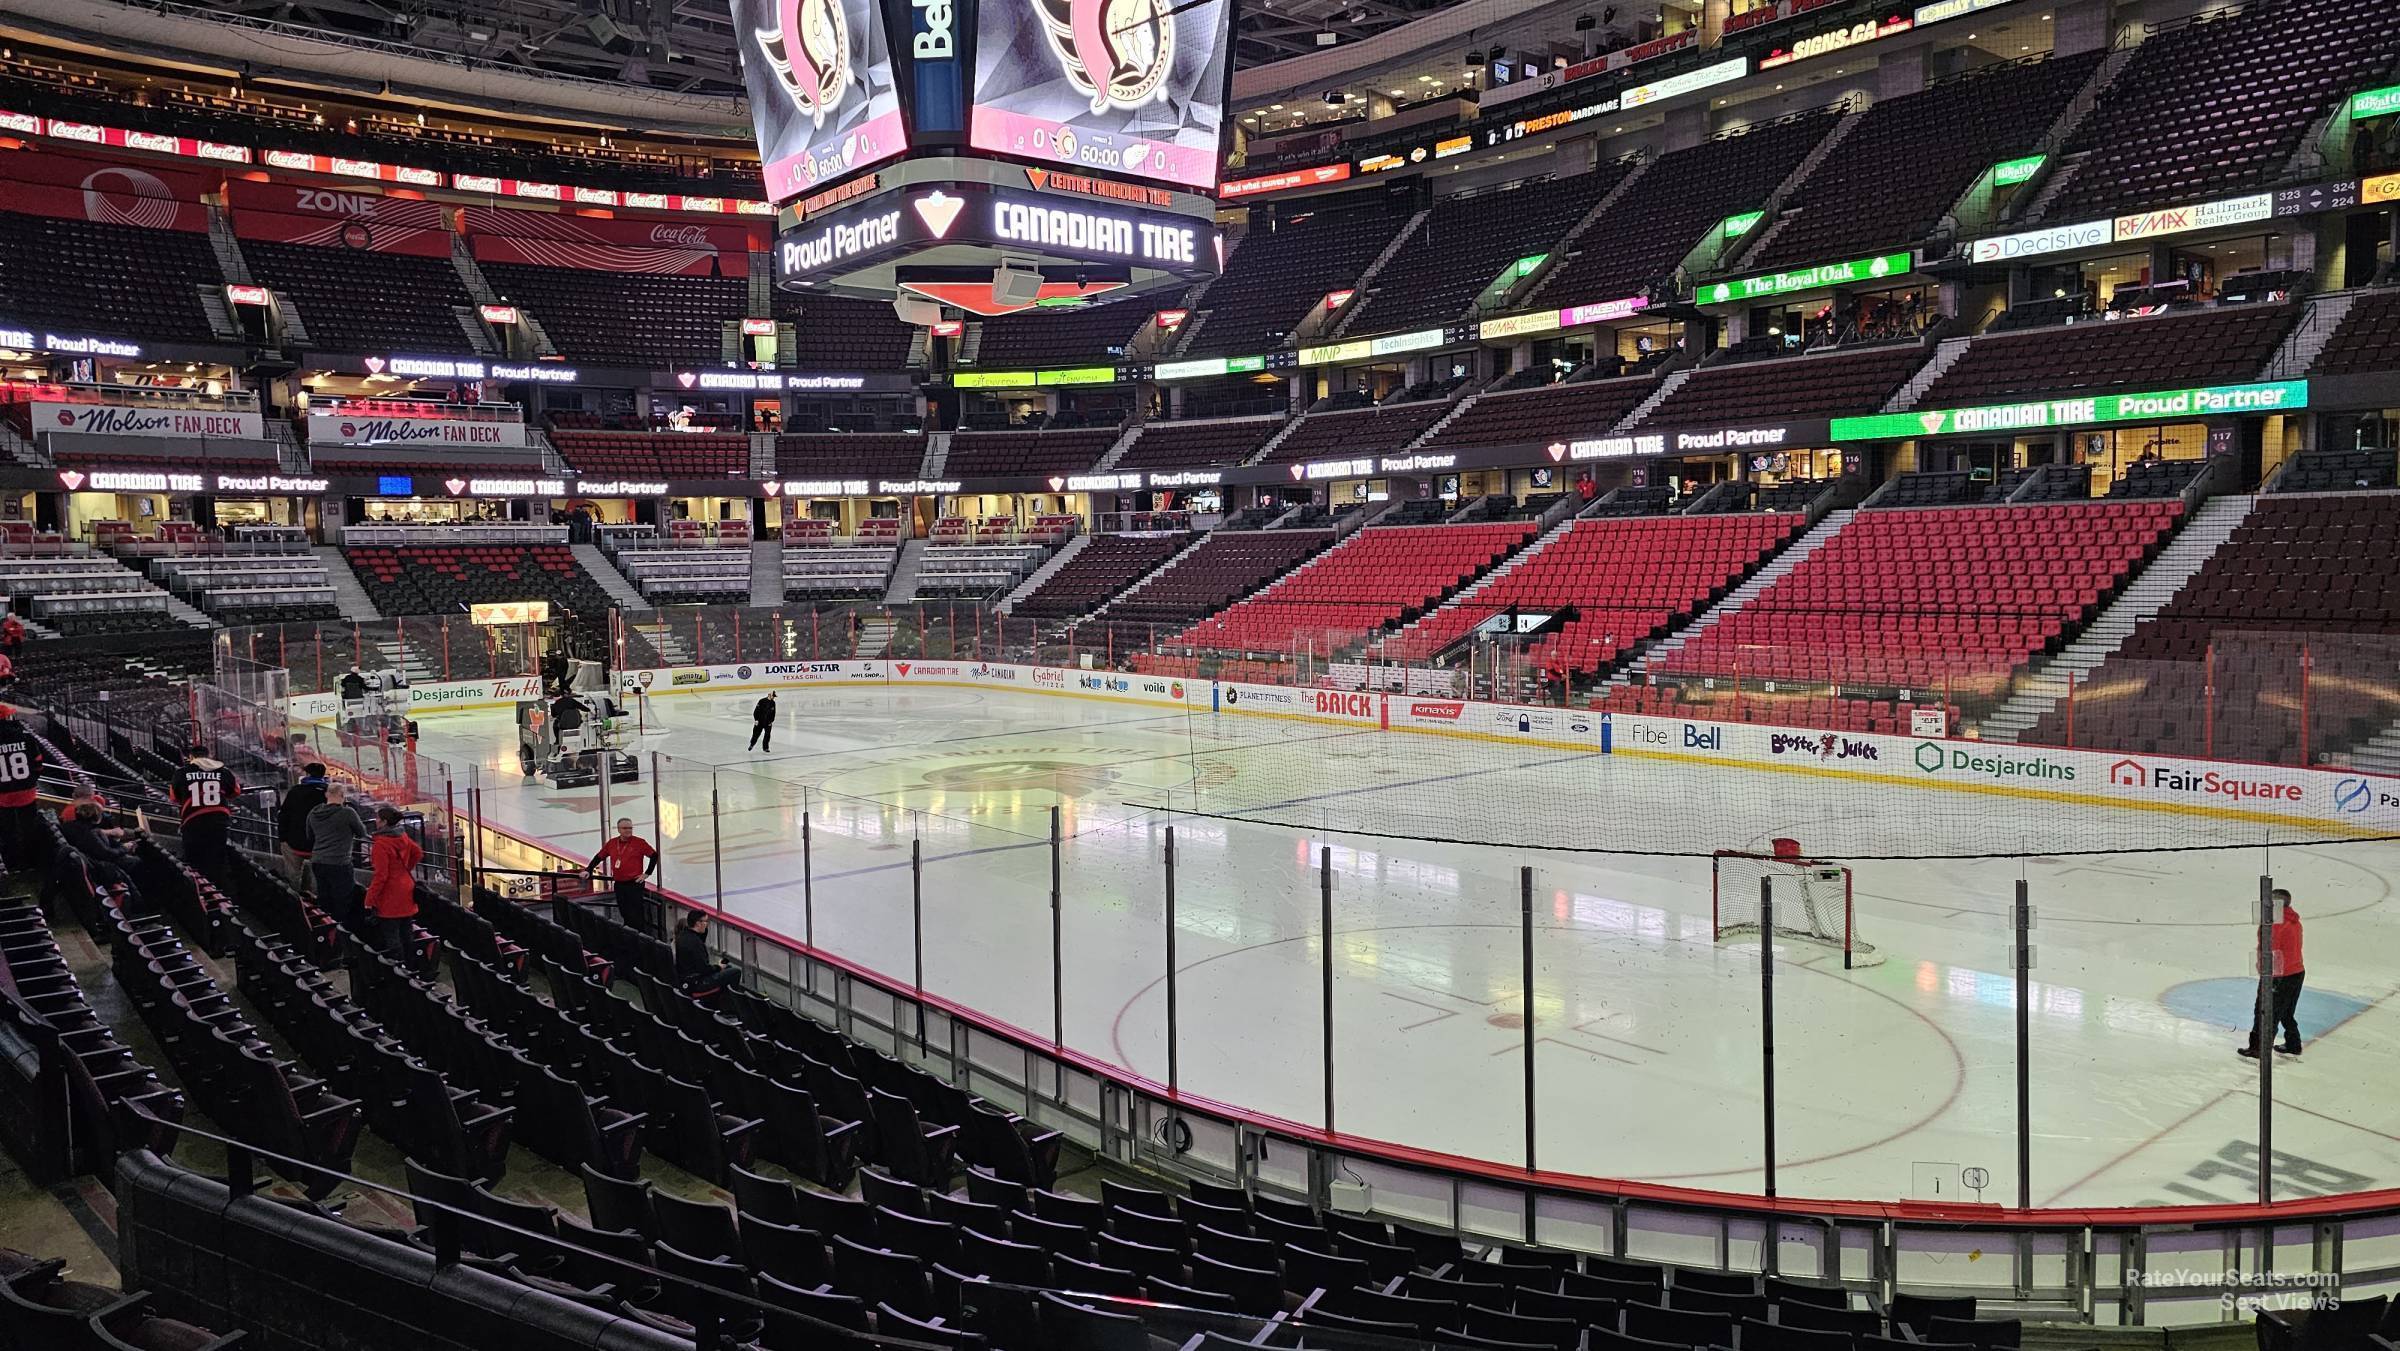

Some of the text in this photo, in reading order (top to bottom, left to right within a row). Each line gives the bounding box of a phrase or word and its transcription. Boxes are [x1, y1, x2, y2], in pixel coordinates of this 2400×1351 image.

[1791, 20, 1877, 60] SIGNS.CA
[1543, 76, 1552, 85] 18
[861, 137, 869, 154] 0
[1033, 128, 1044, 149] 0
[818, 153, 842, 178] 60:00
[1081, 145, 1120, 167] 60:00
[1155, 151, 1166, 170] 0
[793, 164, 801, 182] 0
[1050, 173, 1090, 194] CENTRE
[2279, 181, 2356, 201] 323 324
[296, 188, 377, 216] ZONE
[2278, 195, 2354, 216] 223 224
[2118, 196, 2269, 236] RE/MAX Hallmark
[2195, 208, 2268, 227] Realty Group
[650, 223, 710, 244] Coca-Cola
[994, 201, 1195, 263] CANADIAN TIRE
[784, 211, 901, 275] Proud Partner
[2004, 228, 2101, 258] Decisive
[1743, 263, 1853, 294] The Royal Oak
[1585, 303, 1633, 318] MAGENTA
[46, 335, 88, 353] Proud
[88, 339, 140, 357] Partner
[1444, 336, 1456, 344] 220
[1310, 346, 1341, 362] MNP
[390, 358, 577, 383] CANADIAN TIRE Proud Partner
[788, 375, 823, 388] Proud
[825, 376, 864, 390] Partner
[1954, 387, 2287, 431] CANADIAN TIRE Proud Partner
[78, 407, 242, 436] Molson FAN DECK
[358, 419, 501, 443] Molson FAN DECK
[1570, 427, 1786, 459] CANADIAN TIRE Proud Partner
[2212, 432, 2231, 441] 117
[1381, 456, 1414, 472] Proud
[1415, 453, 1456, 470] Partner
[1845, 455, 1860, 463] 116
[90, 472, 329, 494] CANADIAN TIRE Proud Partner
[470, 479, 668, 497] CANADIAN TIRE Proud Partner
[880, 480, 919, 494] Proud
[919, 479, 961, 494] Partner
[1150, 472, 1179, 486] Proud
[1180, 470, 1222, 486] Partner
[765, 663, 840, 674] LONE STAR
[913, 666, 959, 676] CANADIAN TIRE
[1033, 667, 1064, 684] Gabriel
[412, 685, 483, 703] Desjardins
[492, 681, 520, 699] Tim
[1143, 681, 1166, 694] voilà
[1239, 691, 1292, 704] PLANET FITNESS
[310, 699, 335, 714] Fibe
[1301, 691, 1372, 718] The BRICK
[1496, 712, 1514, 723] Ford
[1632, 724, 1720, 750] Fibe Bell
[1771, 733, 1878, 761] Booster Juice
[0, 752, 30, 783] 18
[1952, 750, 2075, 781] Desjardins
[188, 780, 221, 807] 18
[2154, 768, 2303, 801] FairSquare
